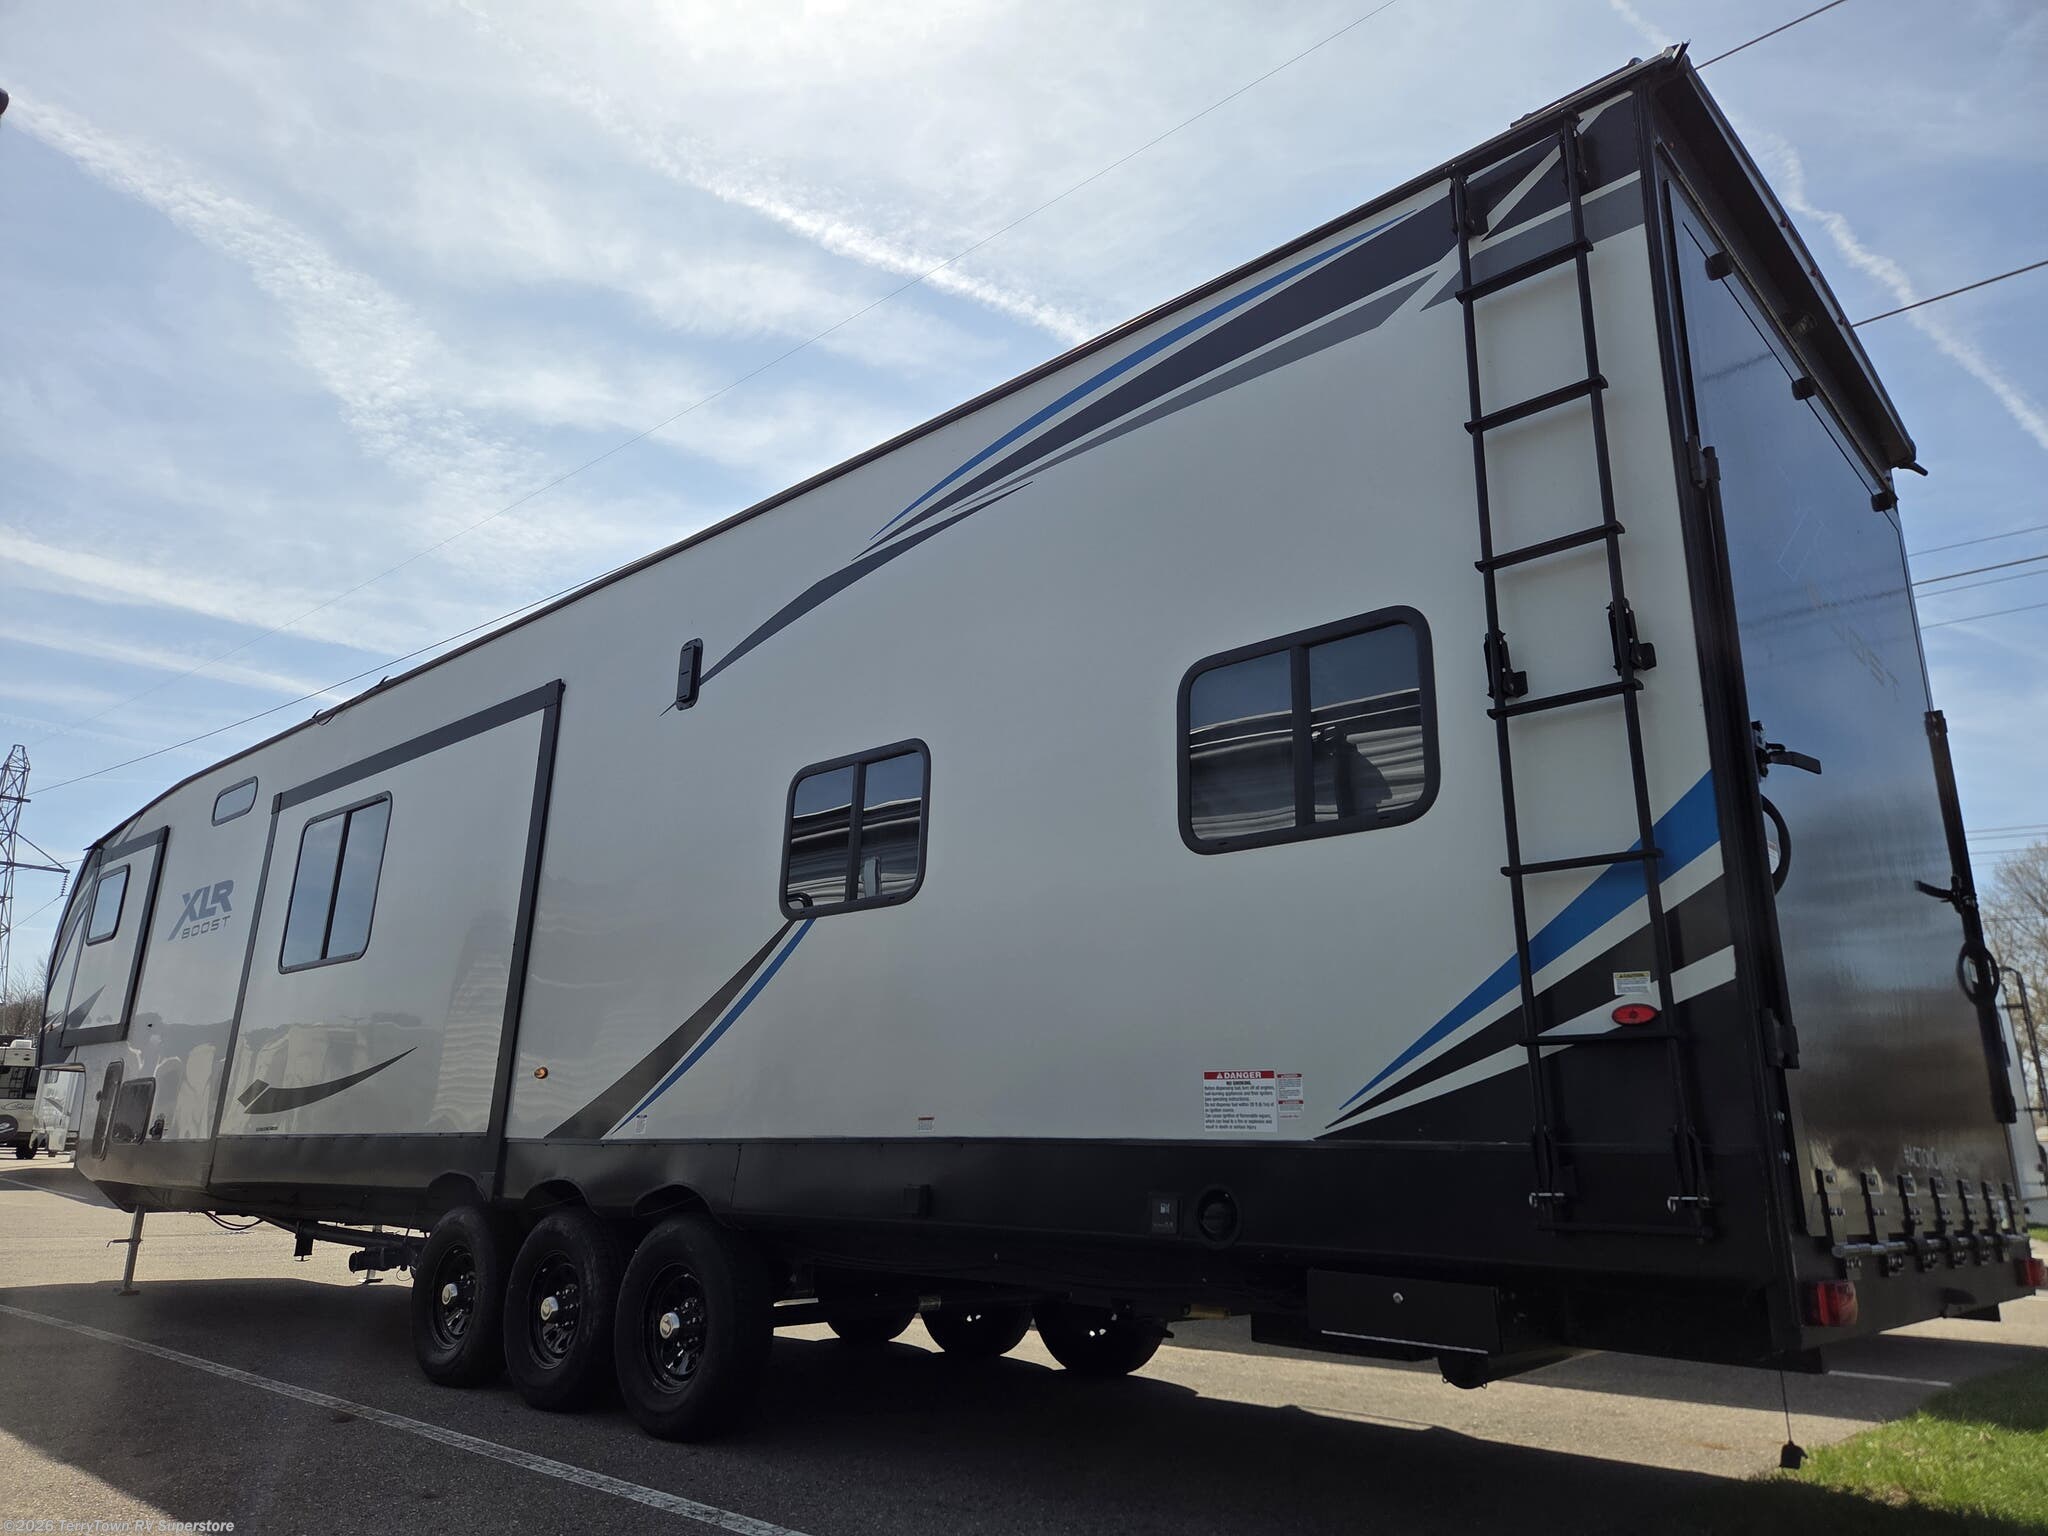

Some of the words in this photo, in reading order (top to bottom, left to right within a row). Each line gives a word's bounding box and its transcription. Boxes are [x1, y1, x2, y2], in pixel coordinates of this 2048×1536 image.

[167, 879, 235, 942] XLR
[181, 914, 232, 940] BOOST
[1223, 1071, 1262, 1079] DANGER
